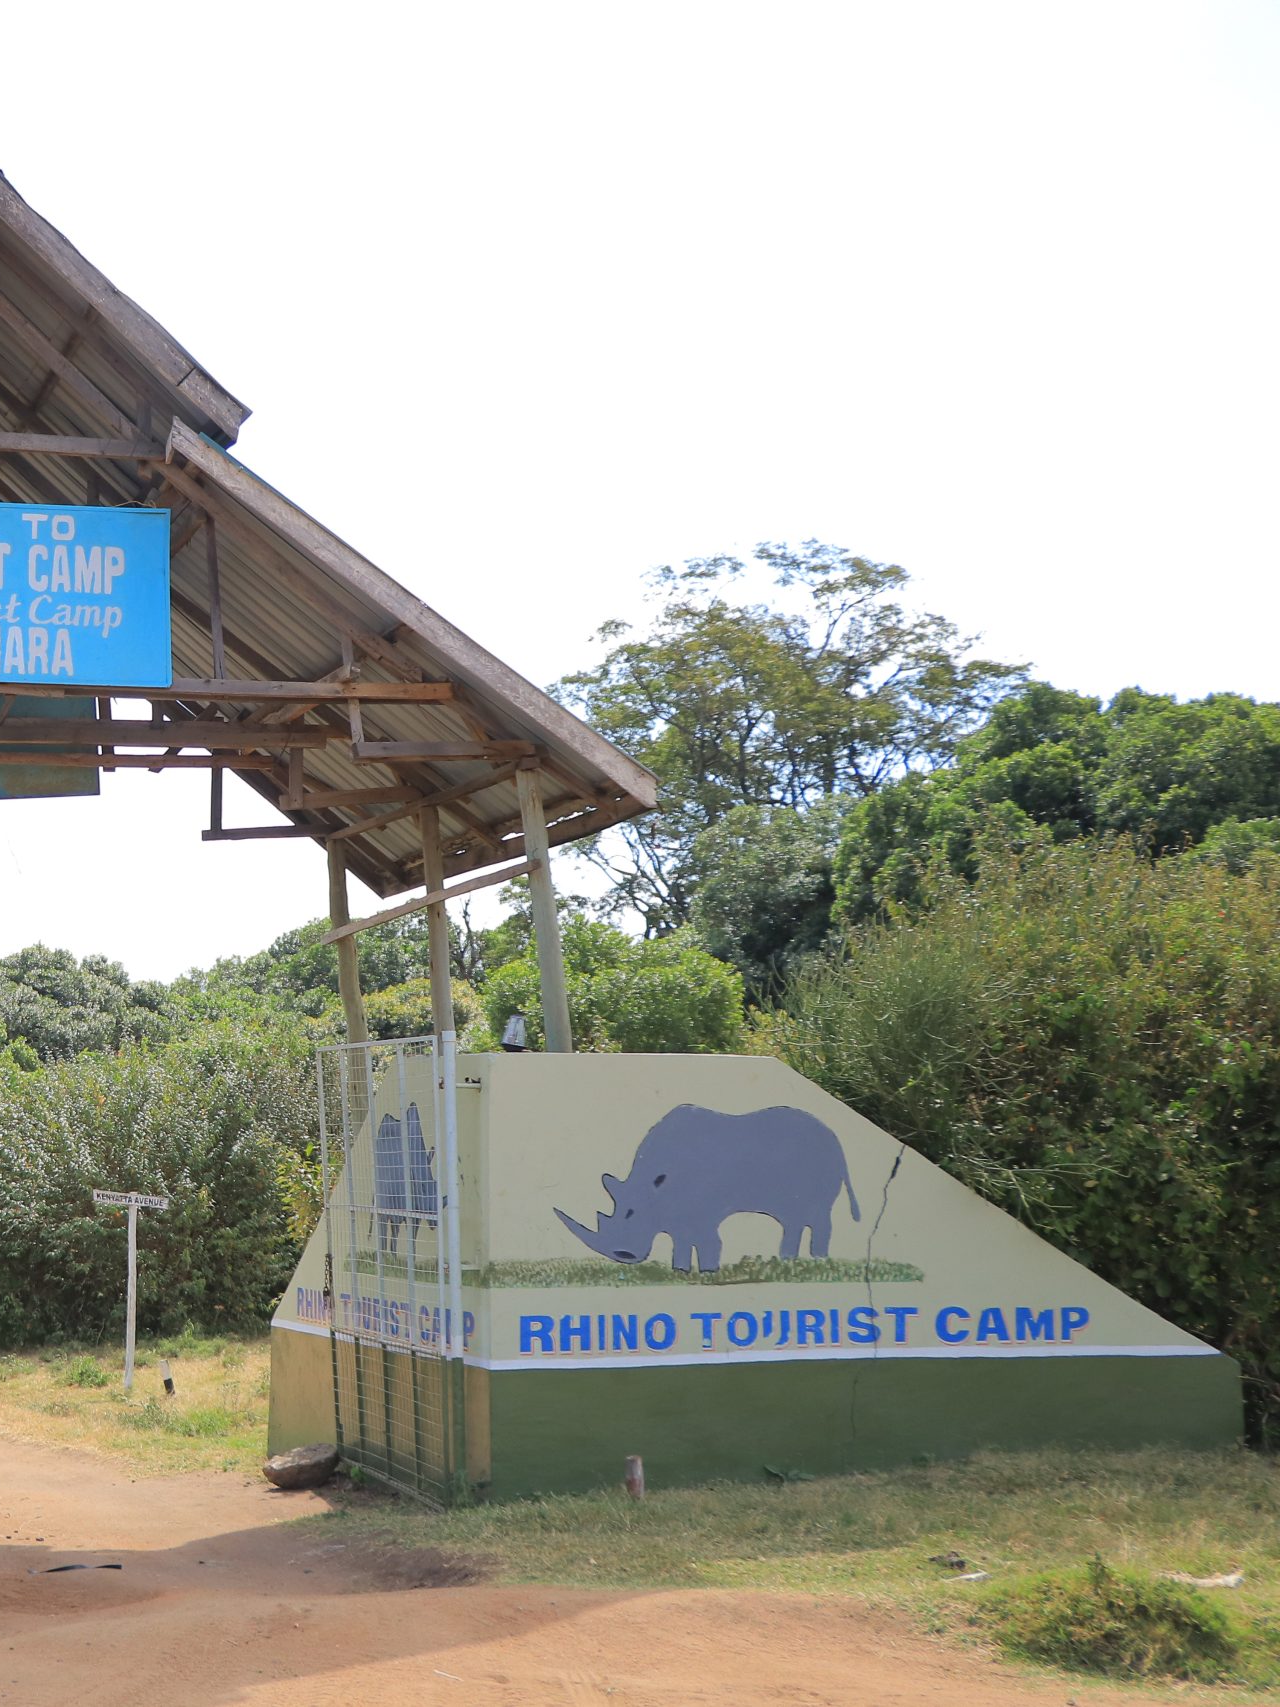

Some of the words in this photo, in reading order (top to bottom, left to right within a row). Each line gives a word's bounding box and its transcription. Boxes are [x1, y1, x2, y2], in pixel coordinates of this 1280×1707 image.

[22, 514, 75, 541] TO
[28, 546, 125, 595] CAMP
[29, 595, 122, 637] Camp
[96, 1192, 133, 1204] KENYATTA
[134, 1196, 164, 1207] AVENUE
[519, 1314, 678, 1355] RHINO
[691, 1306, 919, 1349] TOURIST
[934, 1306, 1091, 1344] CAMP
